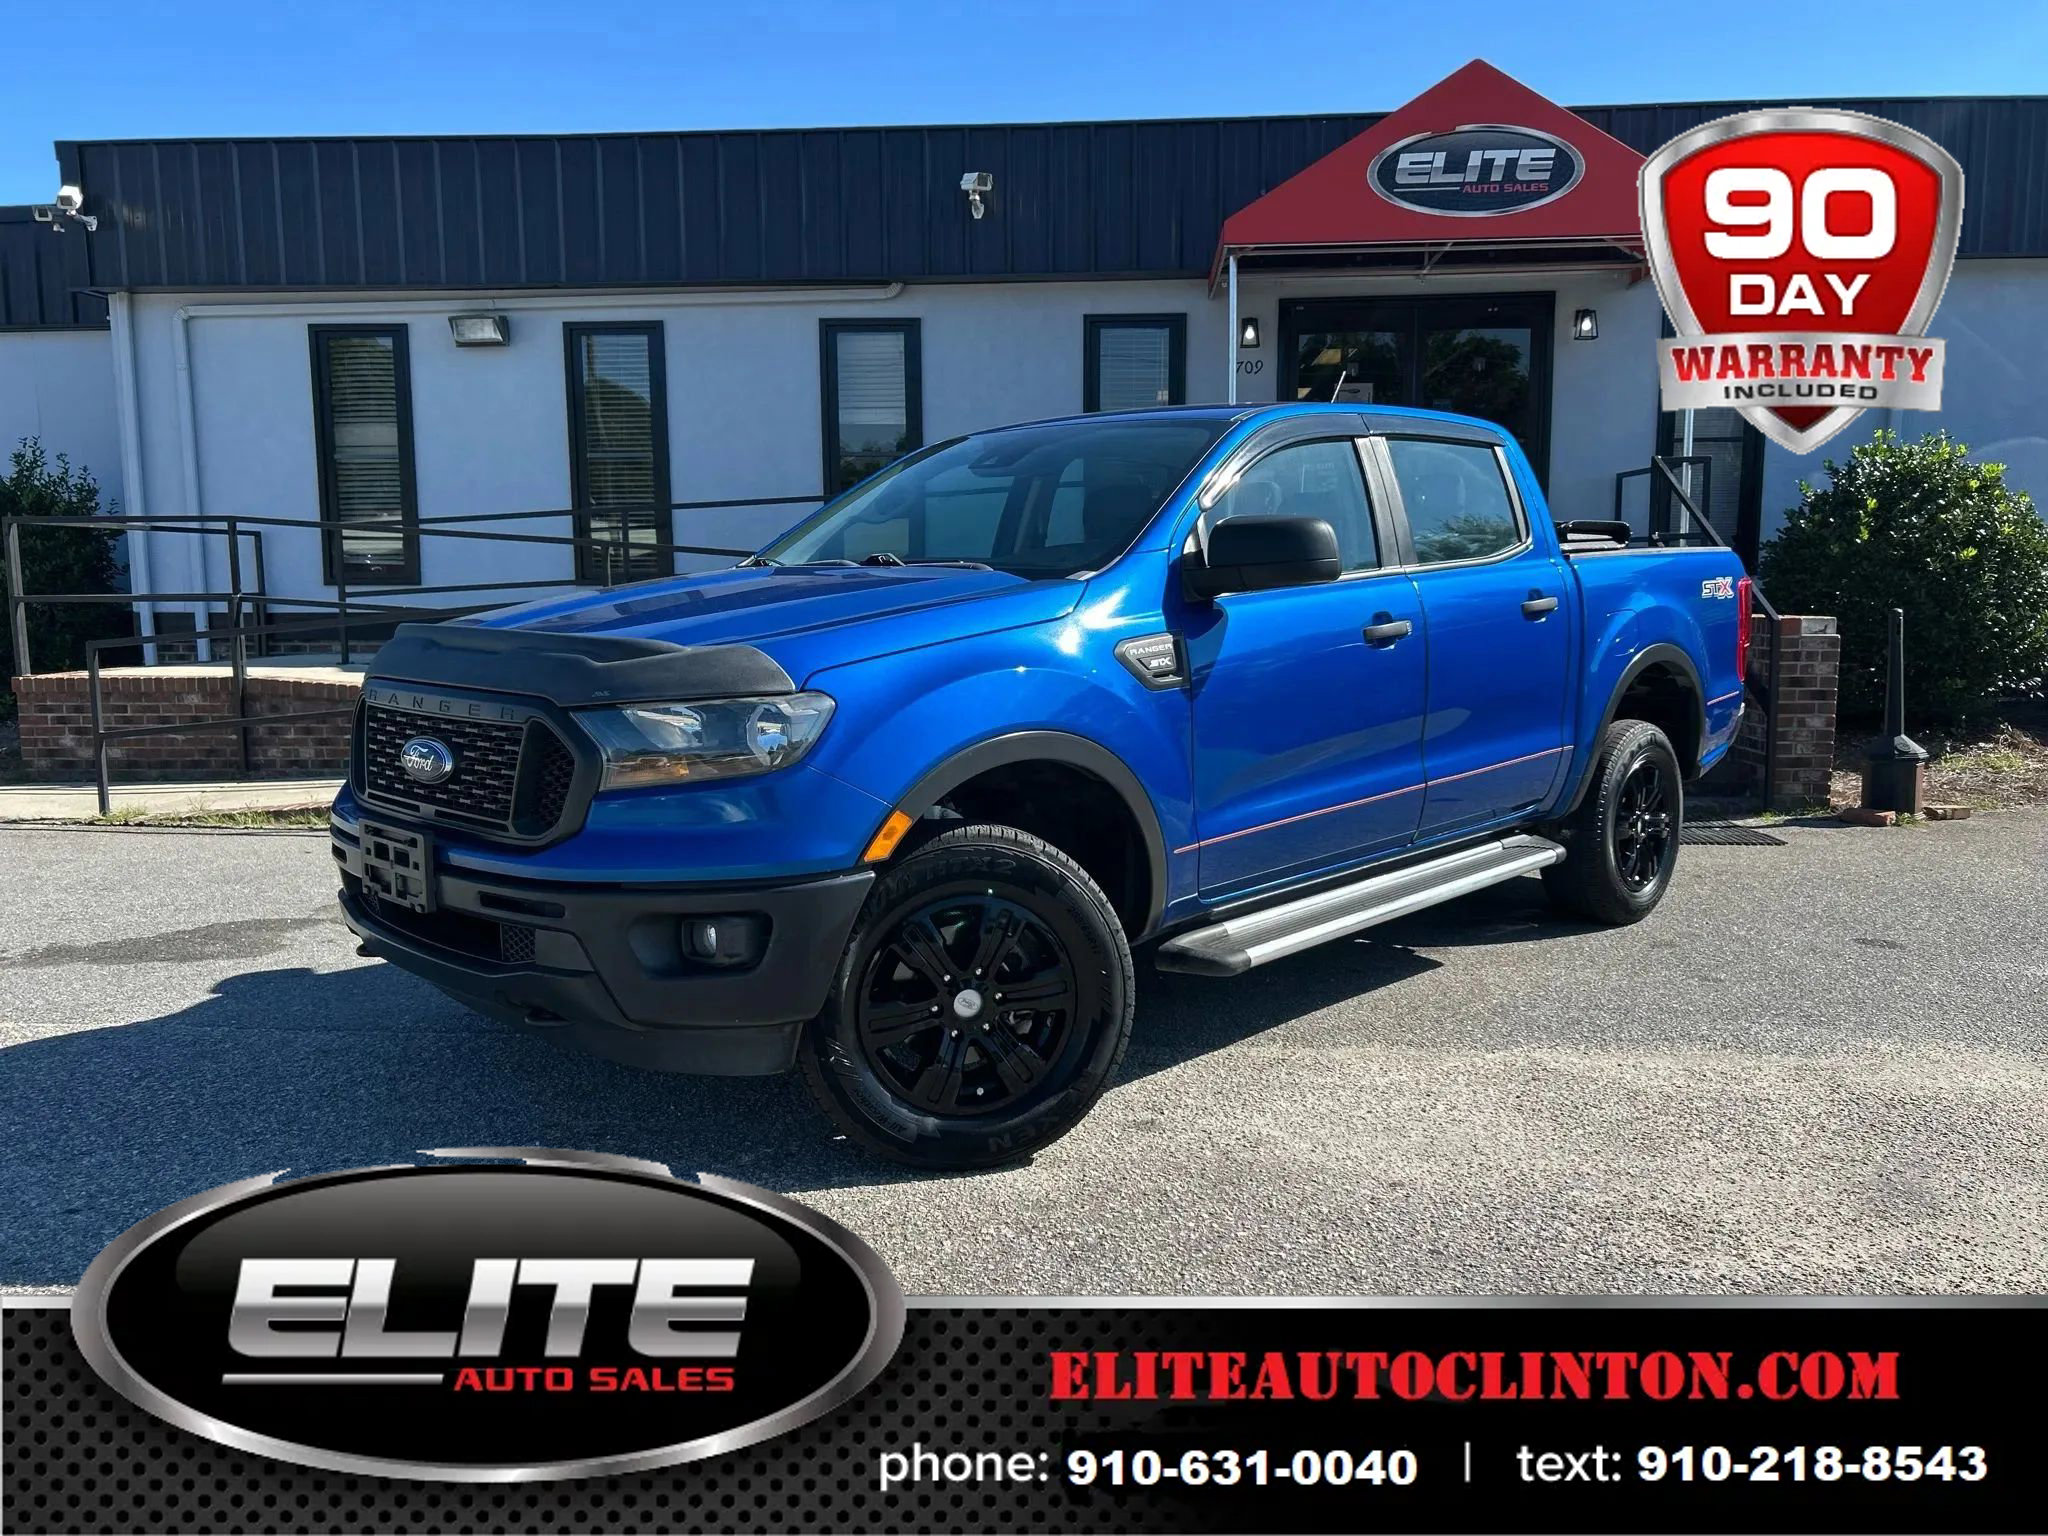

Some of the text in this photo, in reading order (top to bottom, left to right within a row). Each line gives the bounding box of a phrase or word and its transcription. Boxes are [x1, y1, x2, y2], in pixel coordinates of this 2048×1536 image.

[1395, 148, 1556, 184] ELITE
[1462, 182, 1549, 194] AUTO SALES
[1702, 577, 1734, 599] STX
[1129, 644, 1173, 655] RANGER
[1149, 656, 1172, 668] STX
[368, 687, 515, 721] RANGER
[403, 745, 434, 772] Ford
